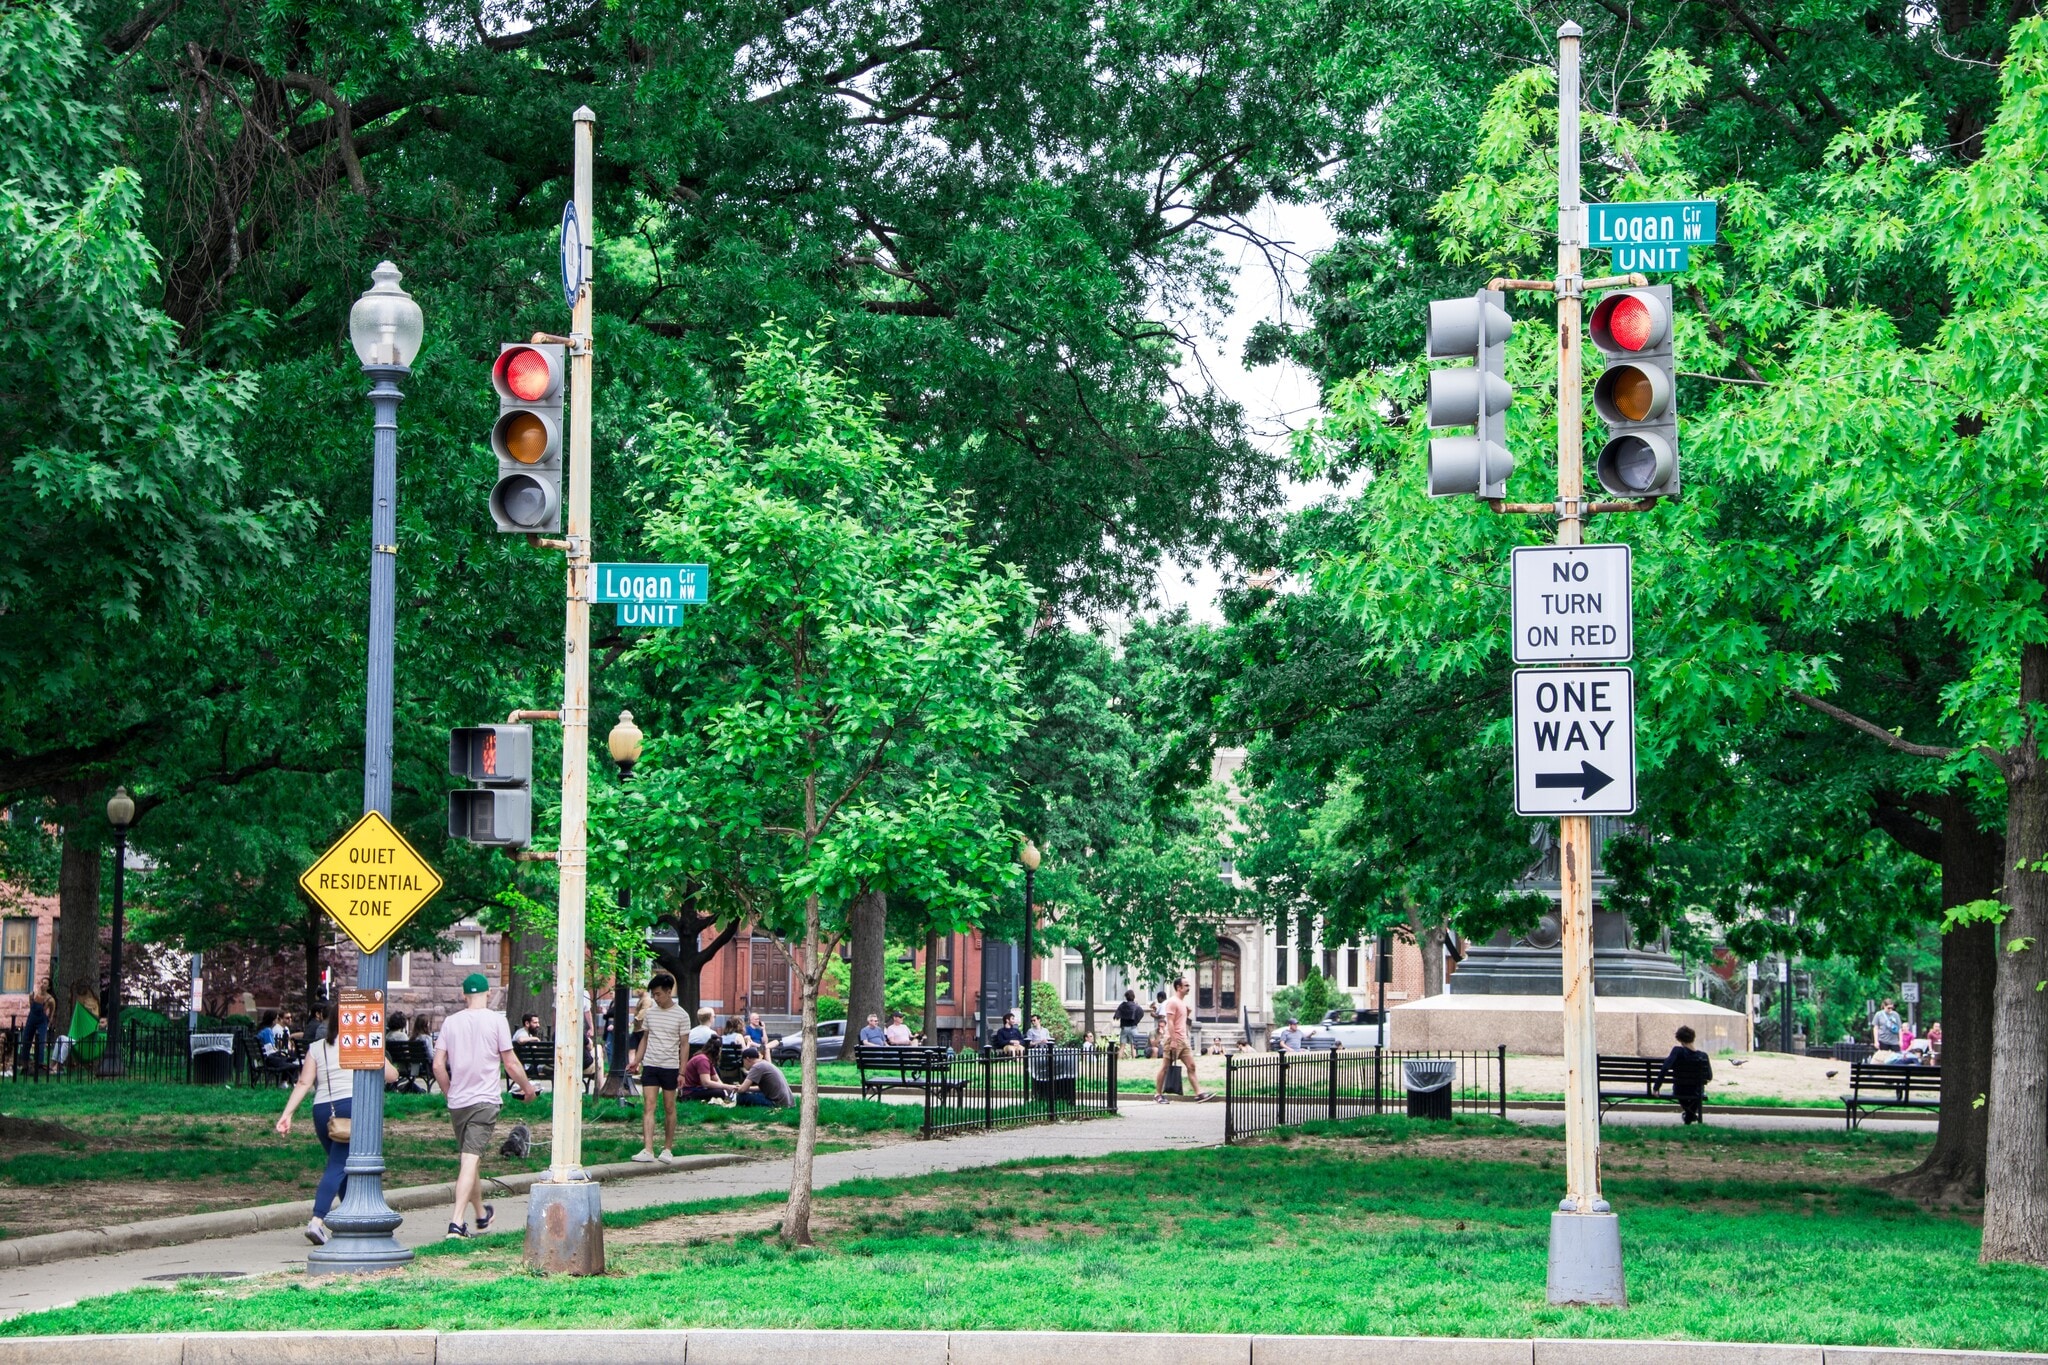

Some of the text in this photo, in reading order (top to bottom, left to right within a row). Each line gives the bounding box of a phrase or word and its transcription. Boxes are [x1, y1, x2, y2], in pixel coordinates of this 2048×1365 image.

[1599, 206, 1701, 243] Logan Cir
[1683, 223, 1701, 240] NW
[1619, 248, 1681, 270] UNIT
[1553, 561, 1589, 582] NO
[606, 568, 696, 603] Logan Cir
[680, 584, 696, 600] NW
[623, 604, 678, 625] UNIT
[1541, 593, 1602, 615] TURN
[1527, 624, 1617, 647] ON RED
[1536, 681, 1612, 713] ONE
[1533, 720, 1615, 752] WAY
[349, 847, 396, 864] QUIET
[319, 873, 423, 891] RESIDENTIAL
[348, 900, 393, 917] ZONE
[1904, 993, 1916, 1001] 25
